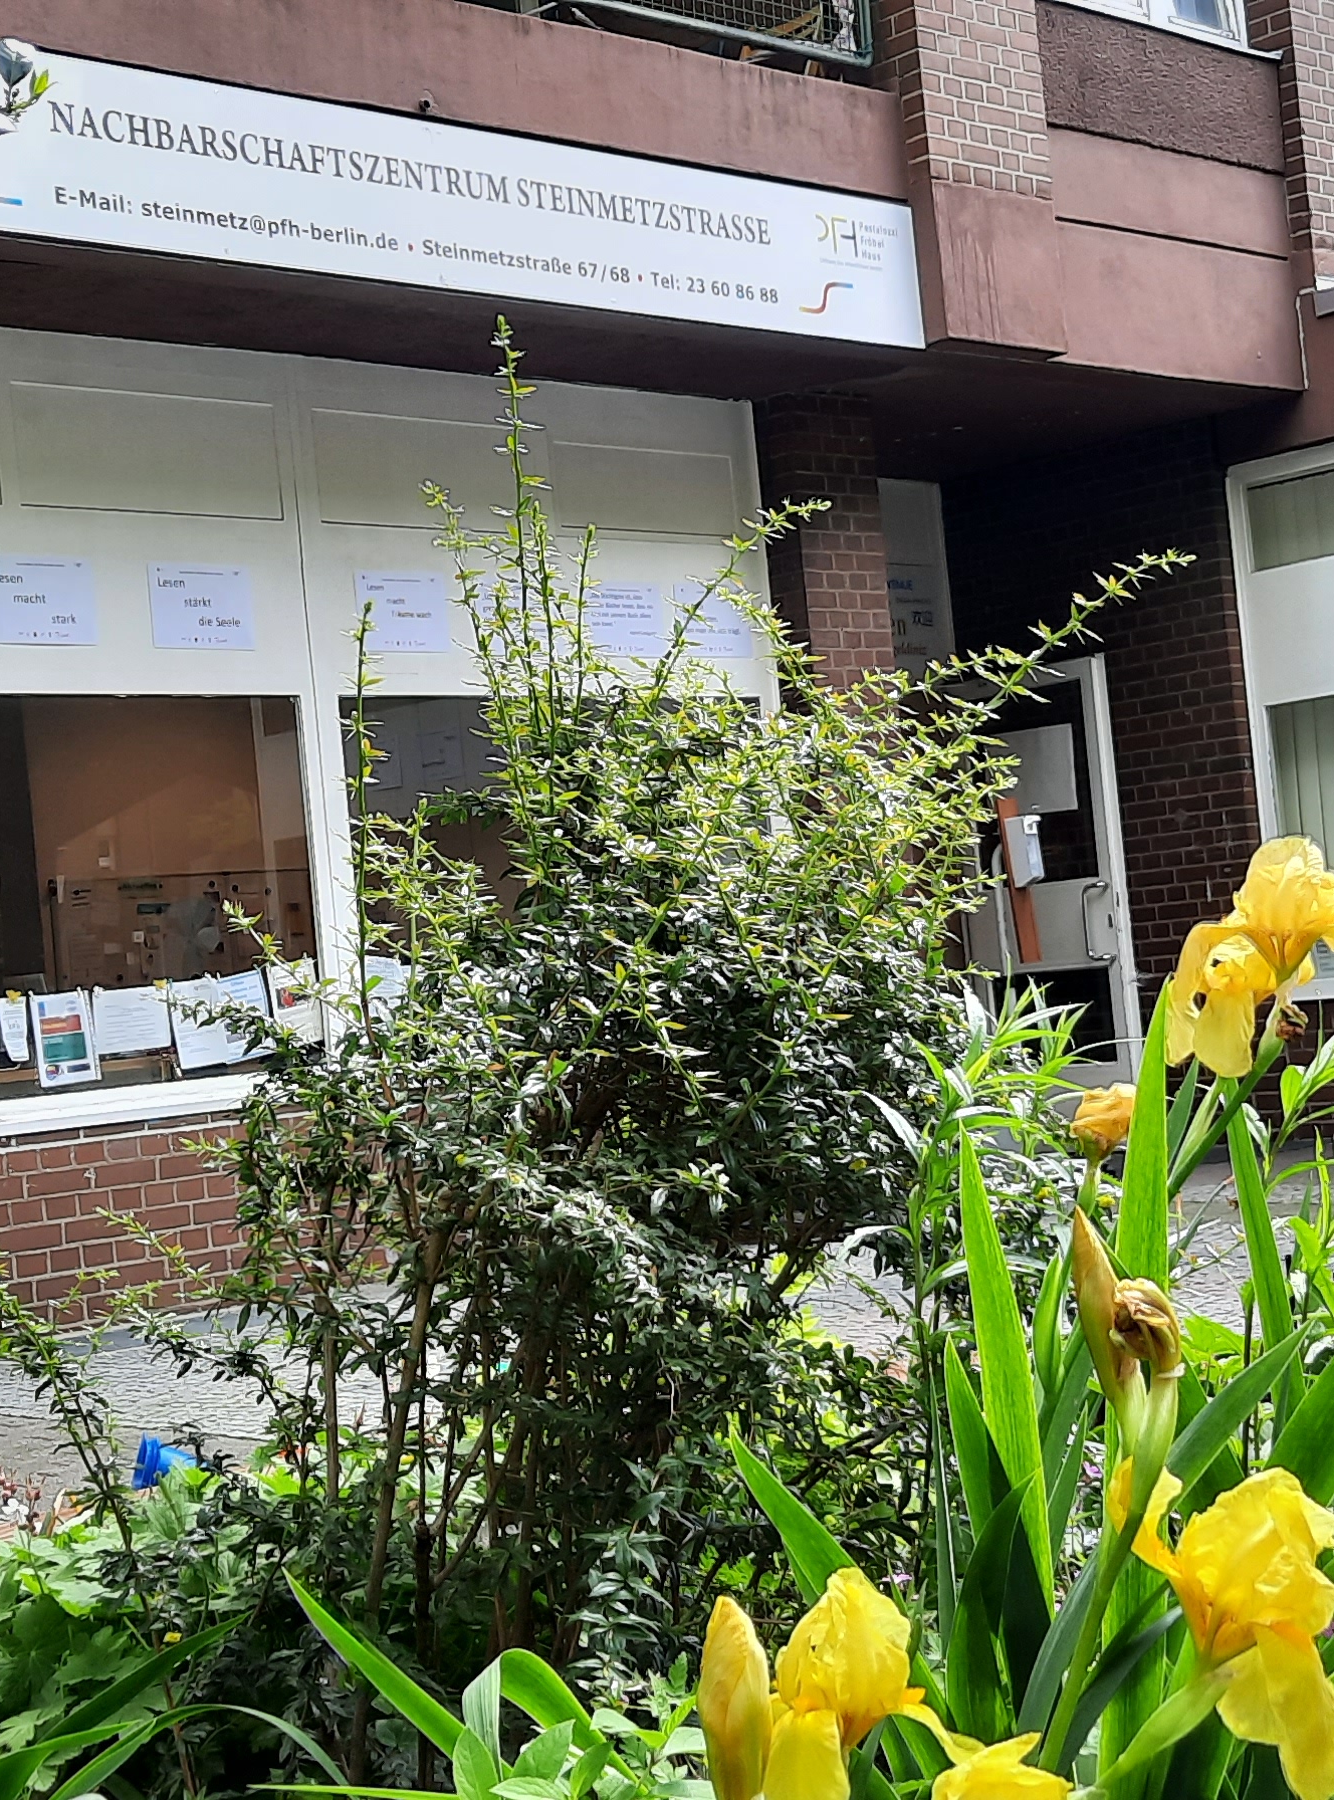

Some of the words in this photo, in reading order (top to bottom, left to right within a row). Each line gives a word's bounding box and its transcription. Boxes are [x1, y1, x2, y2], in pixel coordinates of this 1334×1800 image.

[48, 101, 509, 204] NACHBARSCHAFTSZENTRUM
[516, 178, 772, 246] STEINMETZSTRASSE
[54, 186, 133, 215] E-Mail:
[141, 199, 399, 251] steinmetz@pfh-berlin.de
[422, 238, 572, 277] Steinmetzstraße
[650, 271, 681, 292] Tel:
[686, 276, 707, 295] 23
[710, 279, 731, 298] 60
[735, 283, 755, 301] 86
[759, 286, 779, 304] 88
[157, 577, 186, 589] Lesen
[13, 594, 46, 604] macht
[51, 614, 77, 625] stark
[198, 616, 214, 627] die
